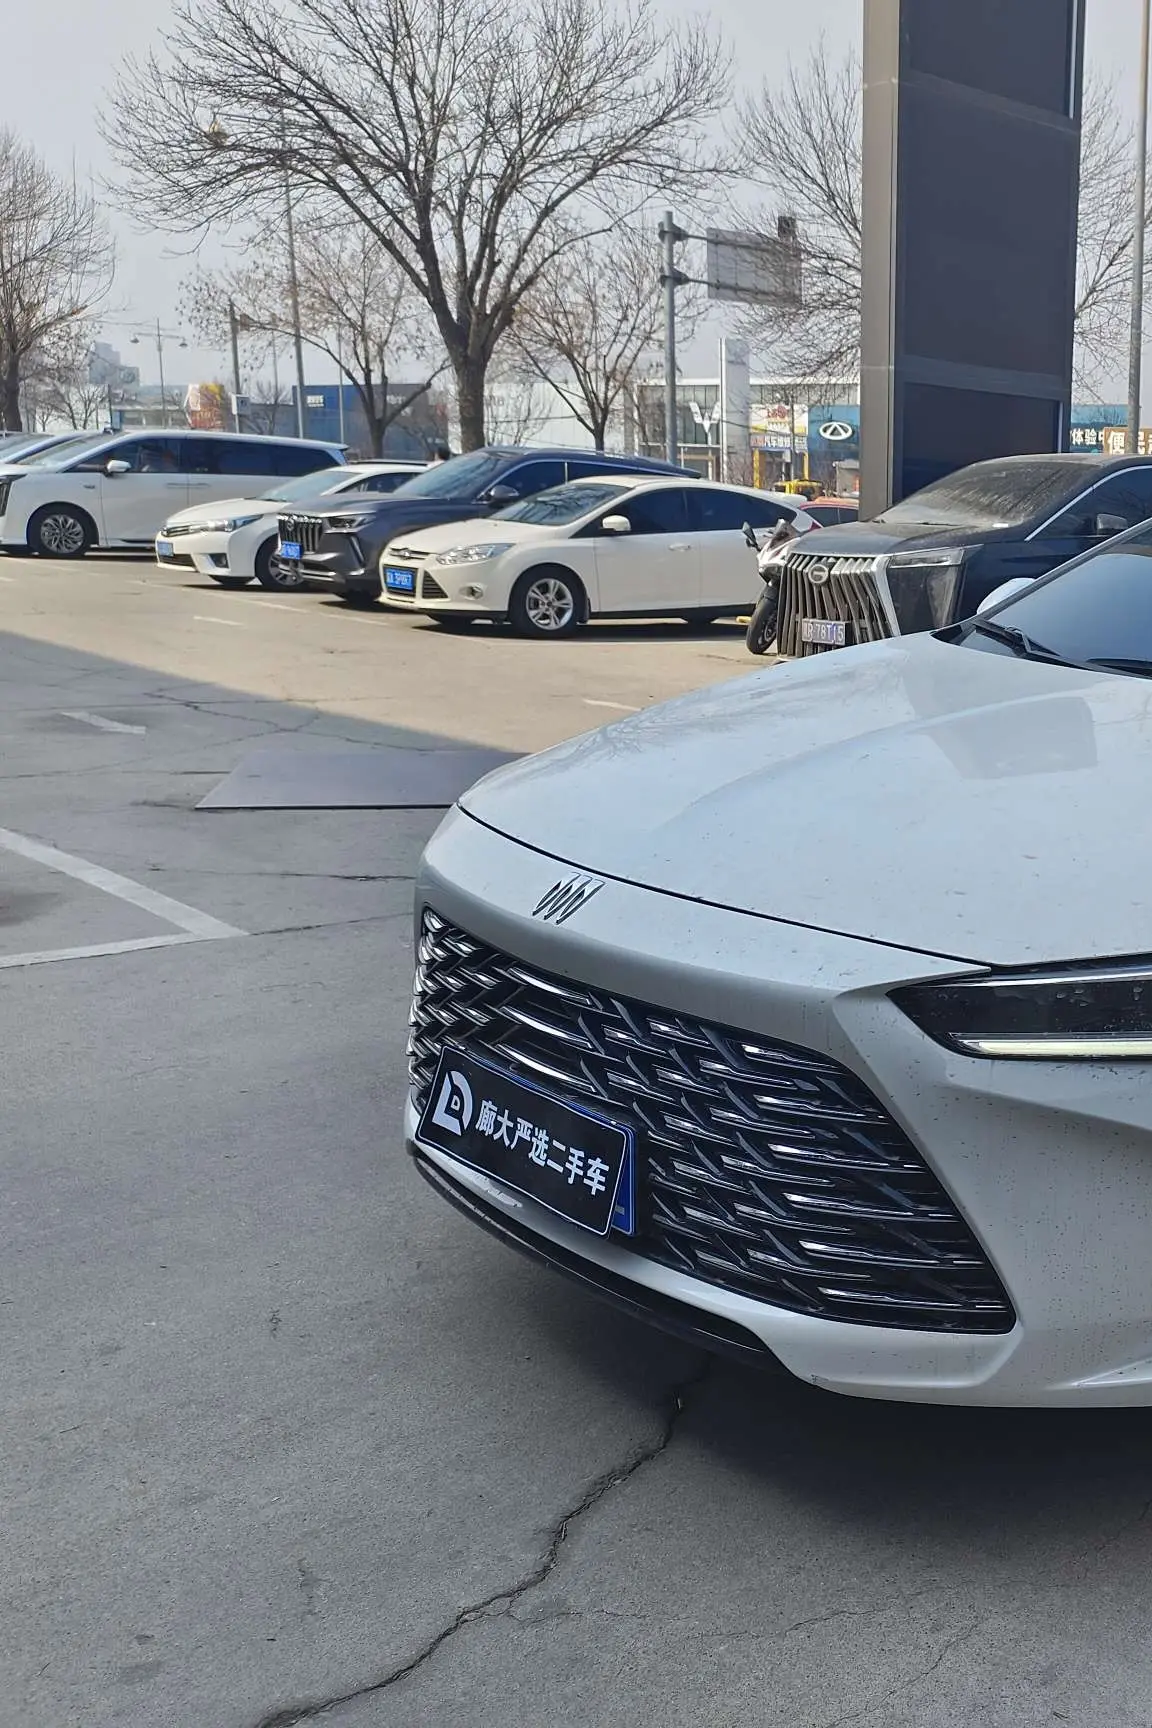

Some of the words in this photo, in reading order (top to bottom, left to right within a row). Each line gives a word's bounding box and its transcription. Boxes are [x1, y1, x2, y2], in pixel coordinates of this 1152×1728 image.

[475, 1099, 610, 1197] 廊大严选二手车
